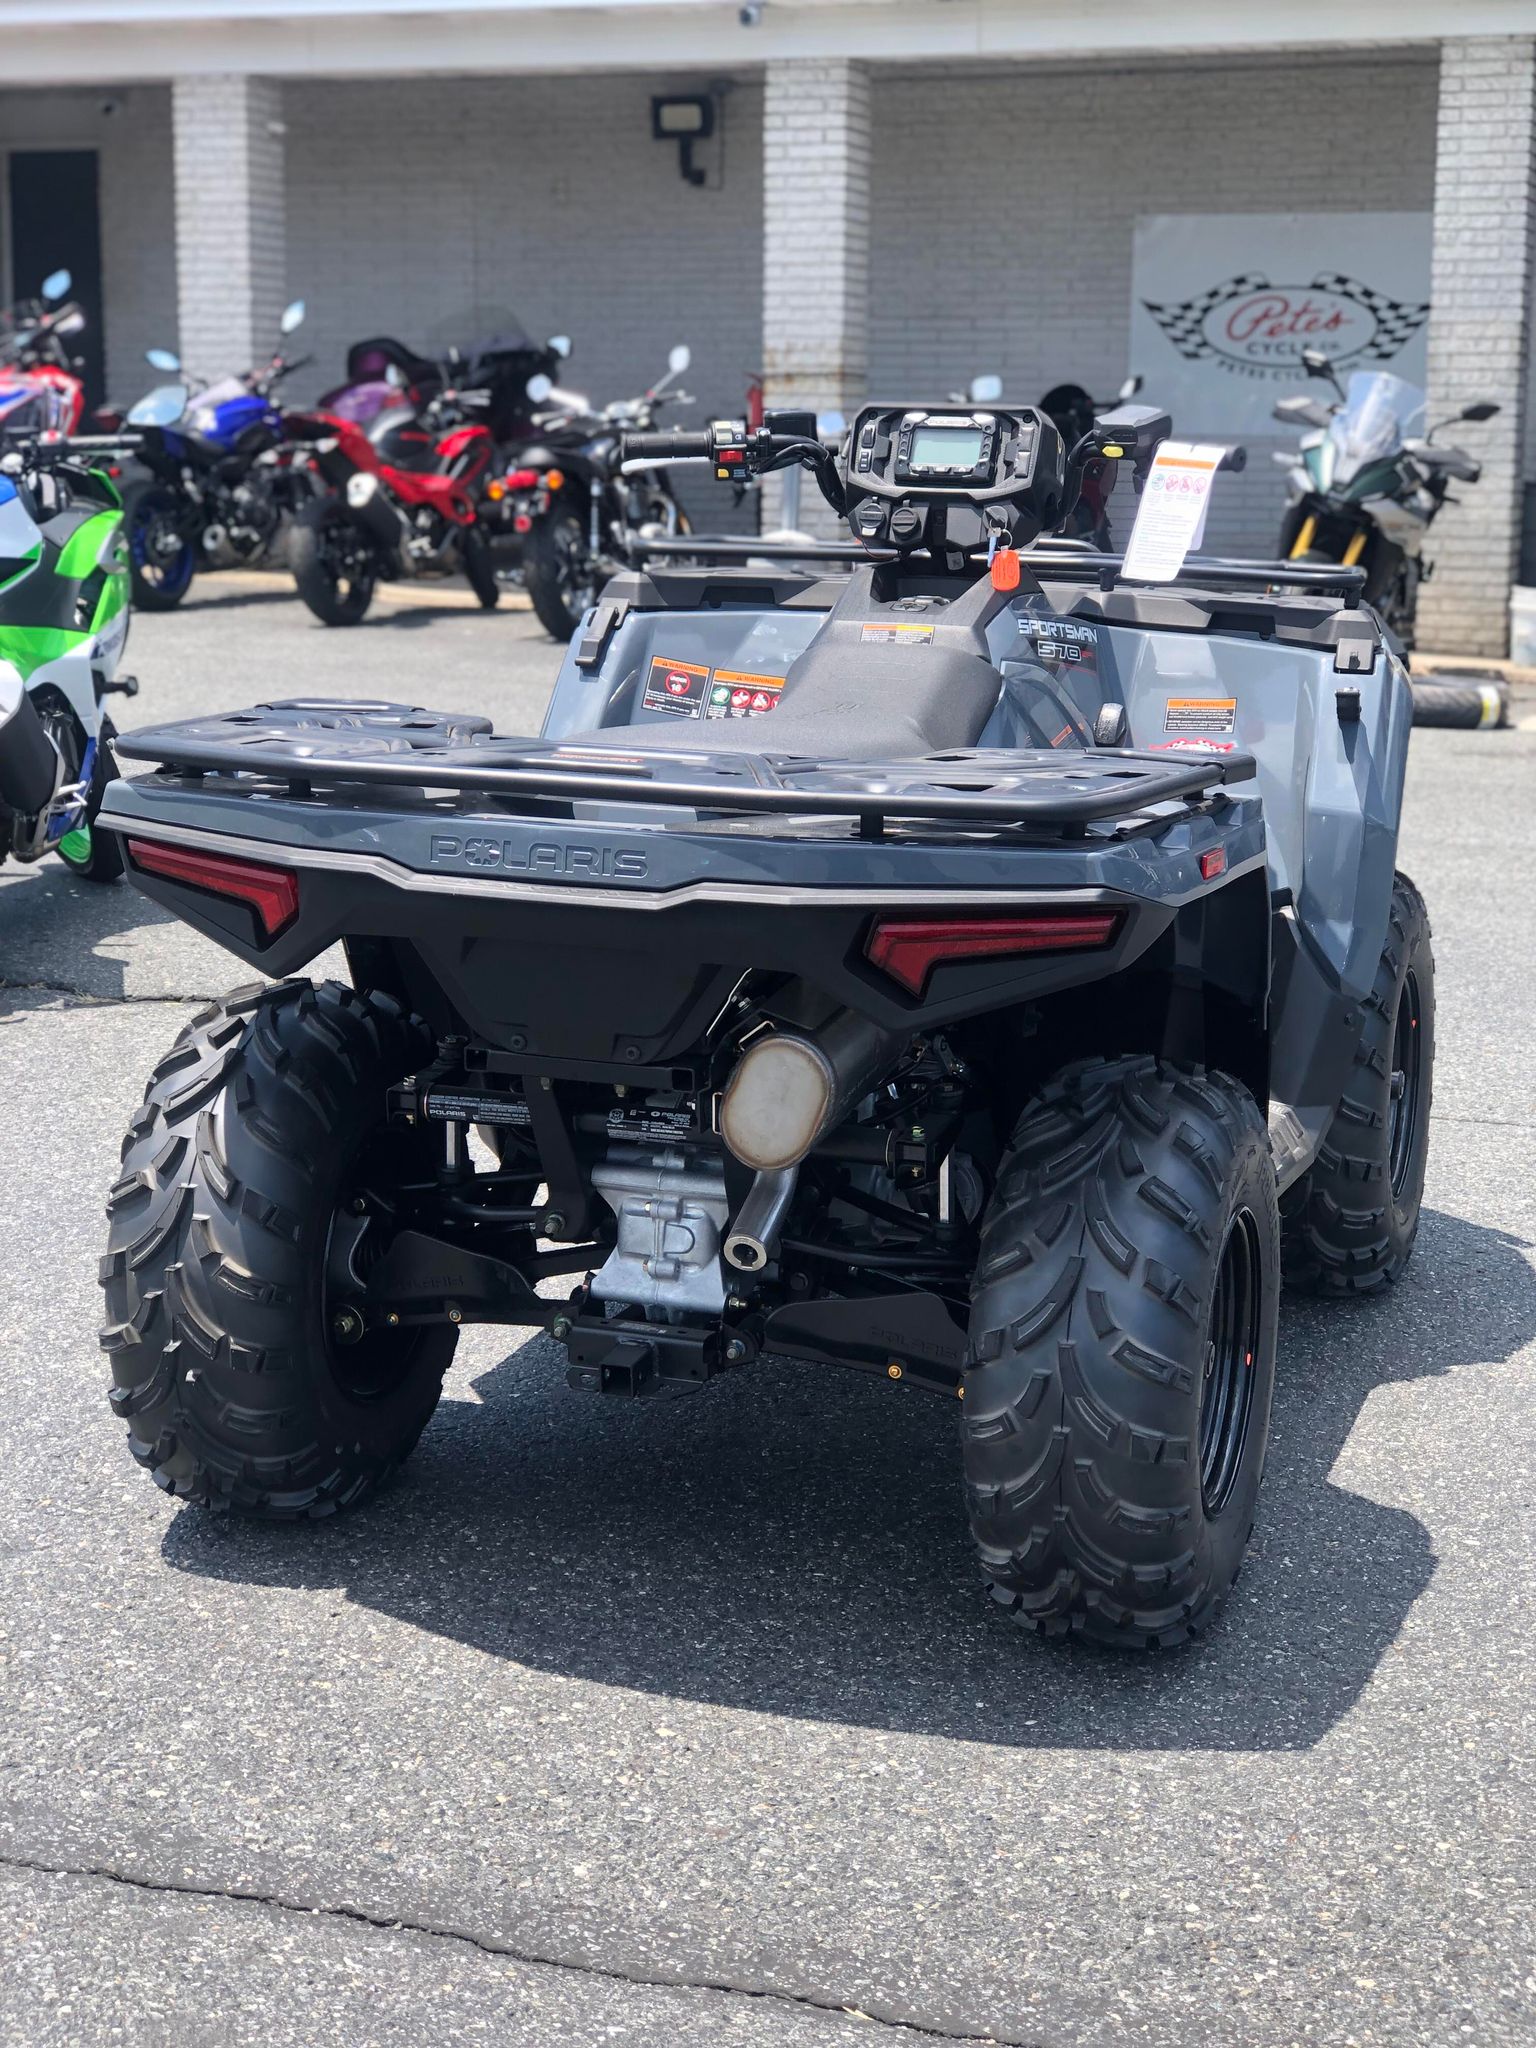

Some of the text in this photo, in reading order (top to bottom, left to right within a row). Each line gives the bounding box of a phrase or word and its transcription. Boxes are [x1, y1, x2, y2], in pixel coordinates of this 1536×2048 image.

[1017, 618, 1099, 643] SPORTSMAN
[1037, 640, 1082, 662] 570
[669, 660, 699, 673] WARNING
[744, 675, 775, 686] WARNING
[670, 683, 683, 692] 16
[429, 834, 649, 879] POLARIS
[429, 1109, 466, 1117] POLARIS
